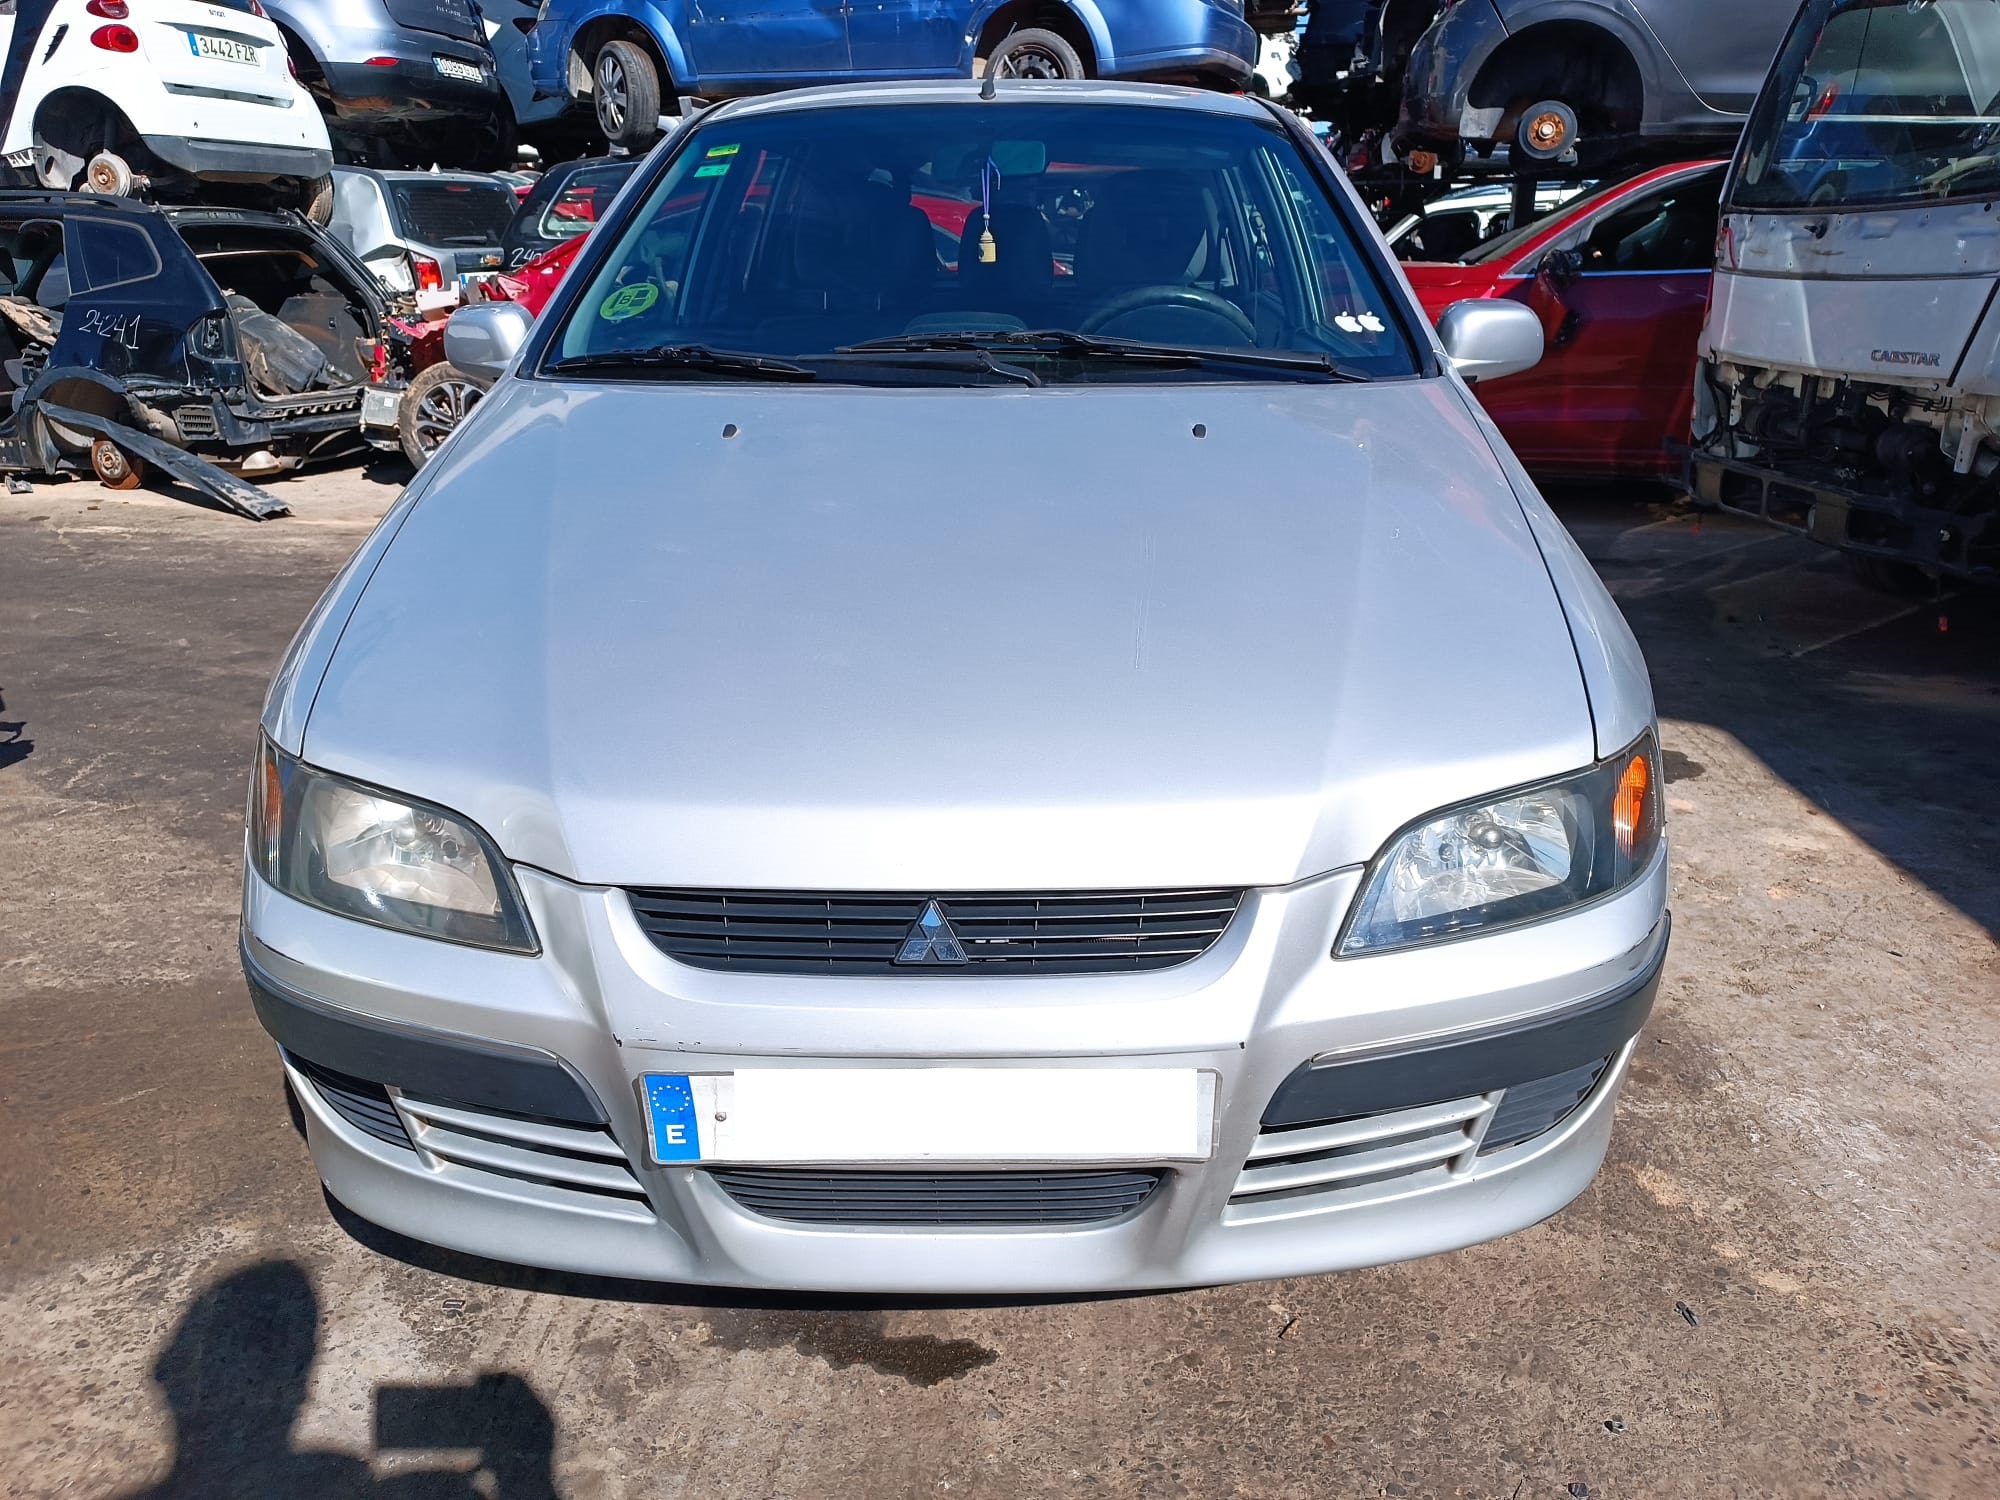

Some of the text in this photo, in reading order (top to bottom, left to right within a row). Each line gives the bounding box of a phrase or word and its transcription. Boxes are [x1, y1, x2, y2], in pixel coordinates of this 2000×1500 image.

[200, 37, 257, 62] 3442 FZR
[78, 309, 141, 349] 24241
[1871, 349, 1941, 366] CABSTAR
[666, 1124, 687, 1144] E
